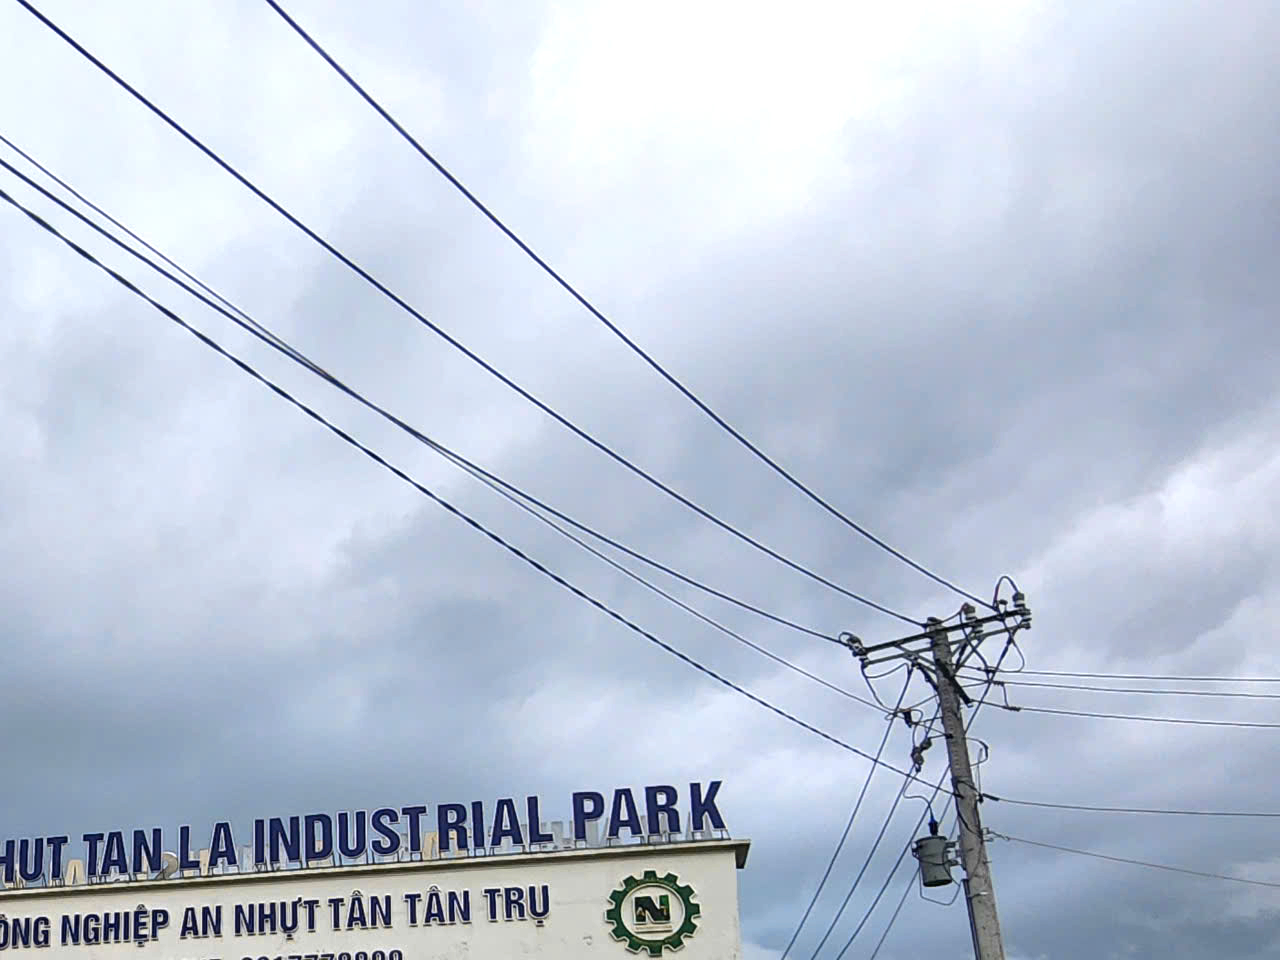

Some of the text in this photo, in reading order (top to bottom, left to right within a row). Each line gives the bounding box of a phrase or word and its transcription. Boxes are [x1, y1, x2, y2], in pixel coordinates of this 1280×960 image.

[82, 826, 162, 877] TAN
[178, 821, 238, 869] LA
[254, 796, 554, 865] INDUSTRIAL
[572, 780, 727, 840] PARK
[60, 903, 170, 946] NGHIỆP
[179, 905, 222, 938] AN
[234, 896, 320, 940] NHỰT
[327, 889, 392, 931] TÂN
[404, 885, 472, 926] TÂN
[482, 884, 551, 926] TRỤ
